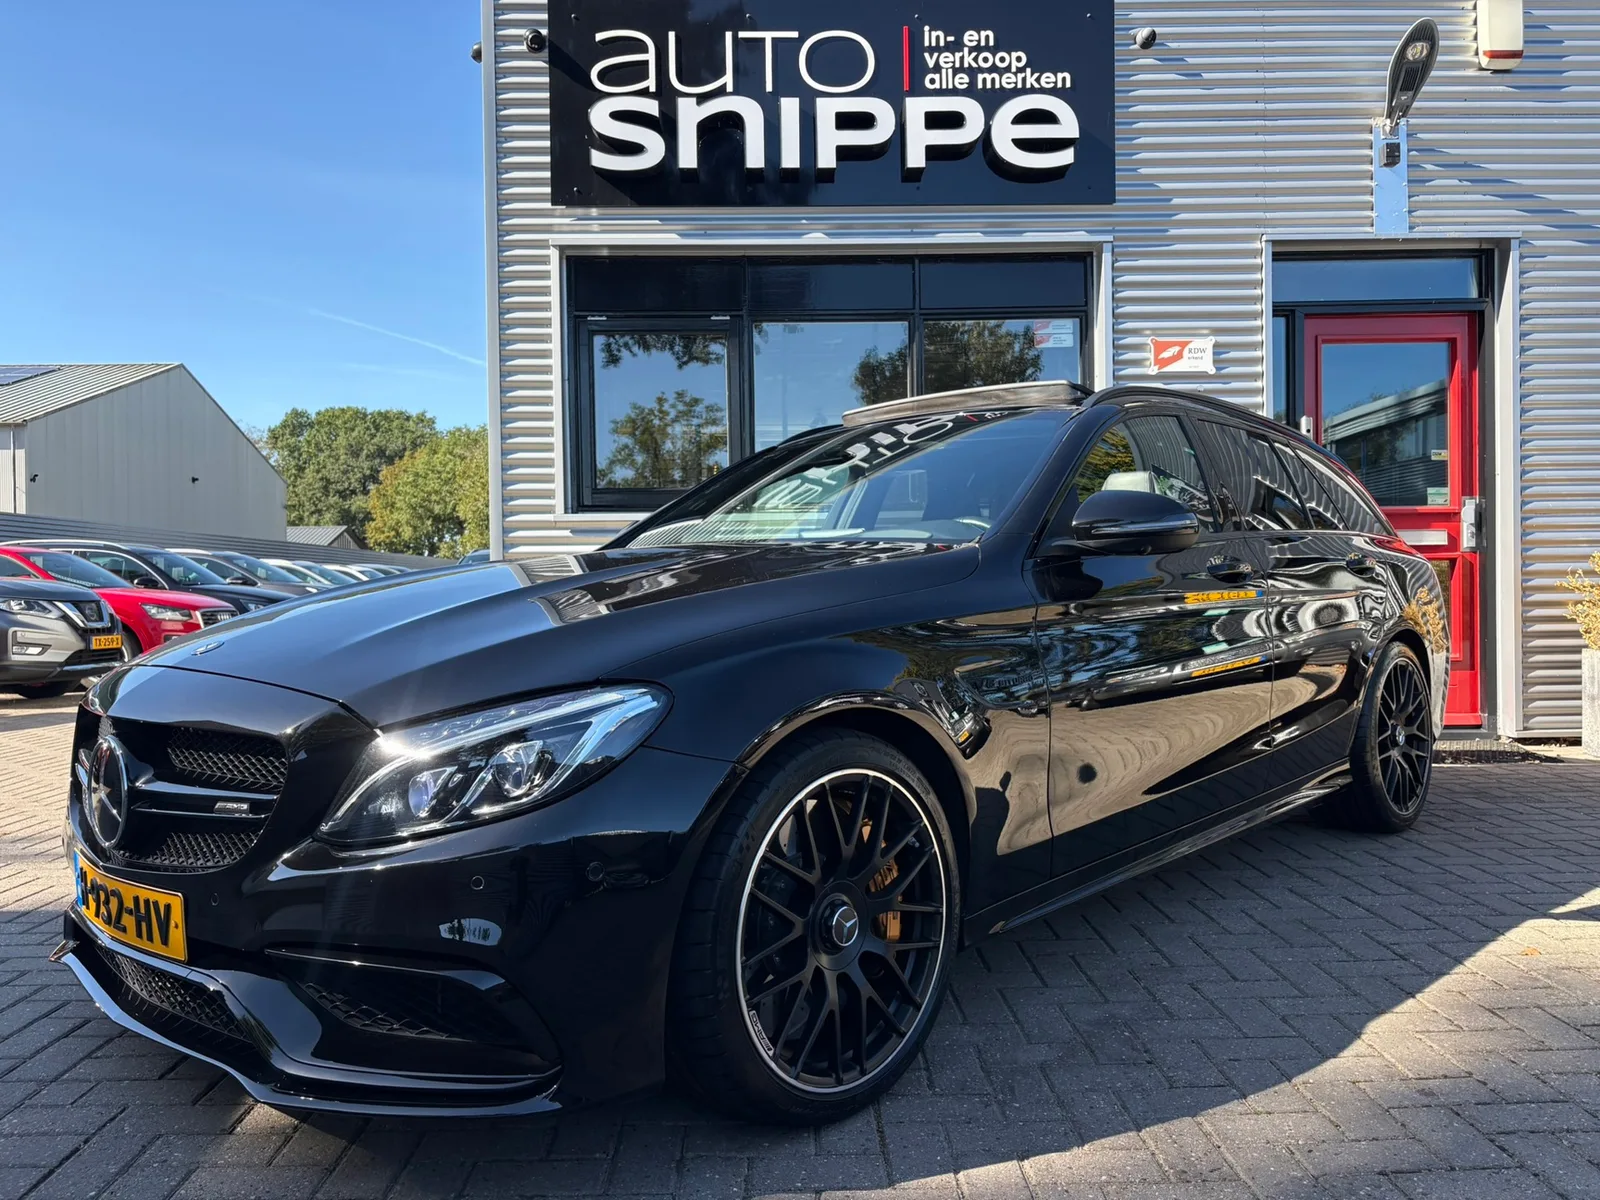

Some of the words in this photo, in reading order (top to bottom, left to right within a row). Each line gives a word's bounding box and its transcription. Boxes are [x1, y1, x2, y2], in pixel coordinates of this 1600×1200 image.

[924, 25, 955, 47] in-
[963, 29, 994, 47] en
[924, 47, 1027, 73] verkoop
[925, 68, 969, 90] alle
[978, 67, 1071, 90] merken
[94, 636, 119, 647] TX-259-X
